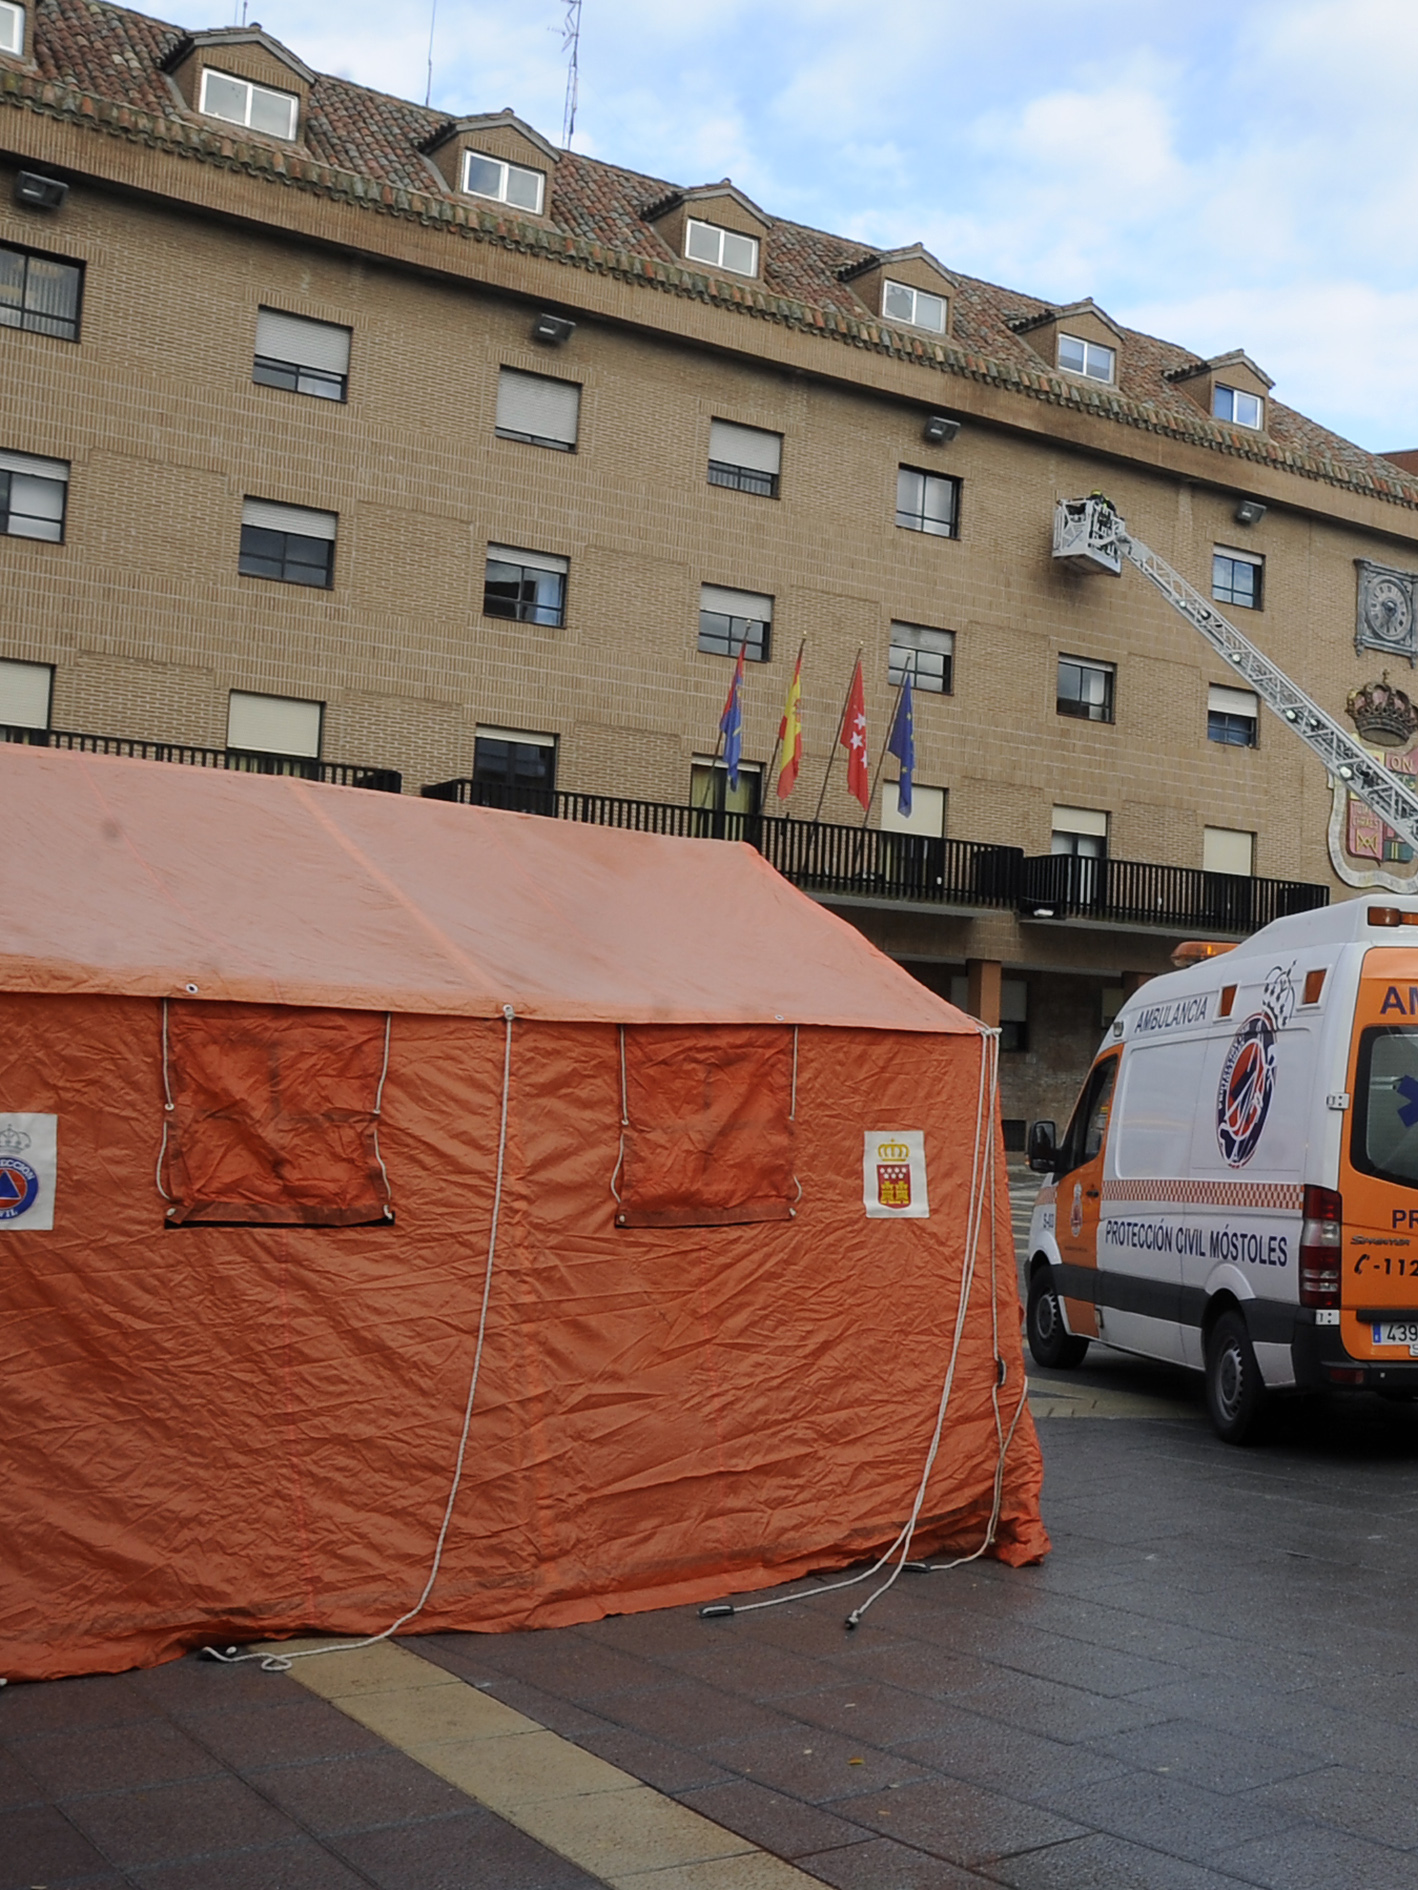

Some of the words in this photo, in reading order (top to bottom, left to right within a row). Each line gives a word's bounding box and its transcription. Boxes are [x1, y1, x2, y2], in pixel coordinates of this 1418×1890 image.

[1134, 997, 1208, 1033] AMBULANCIA
[0, 1159, 35, 1180] ECCION
[0, 1209, 18, 1217] VIL
[1105, 1219, 1172, 1252] PROTECCIÓN
[1176, 1227, 1206, 1257] CIVIL
[1210, 1224, 1288, 1267] MÓSTOLES
